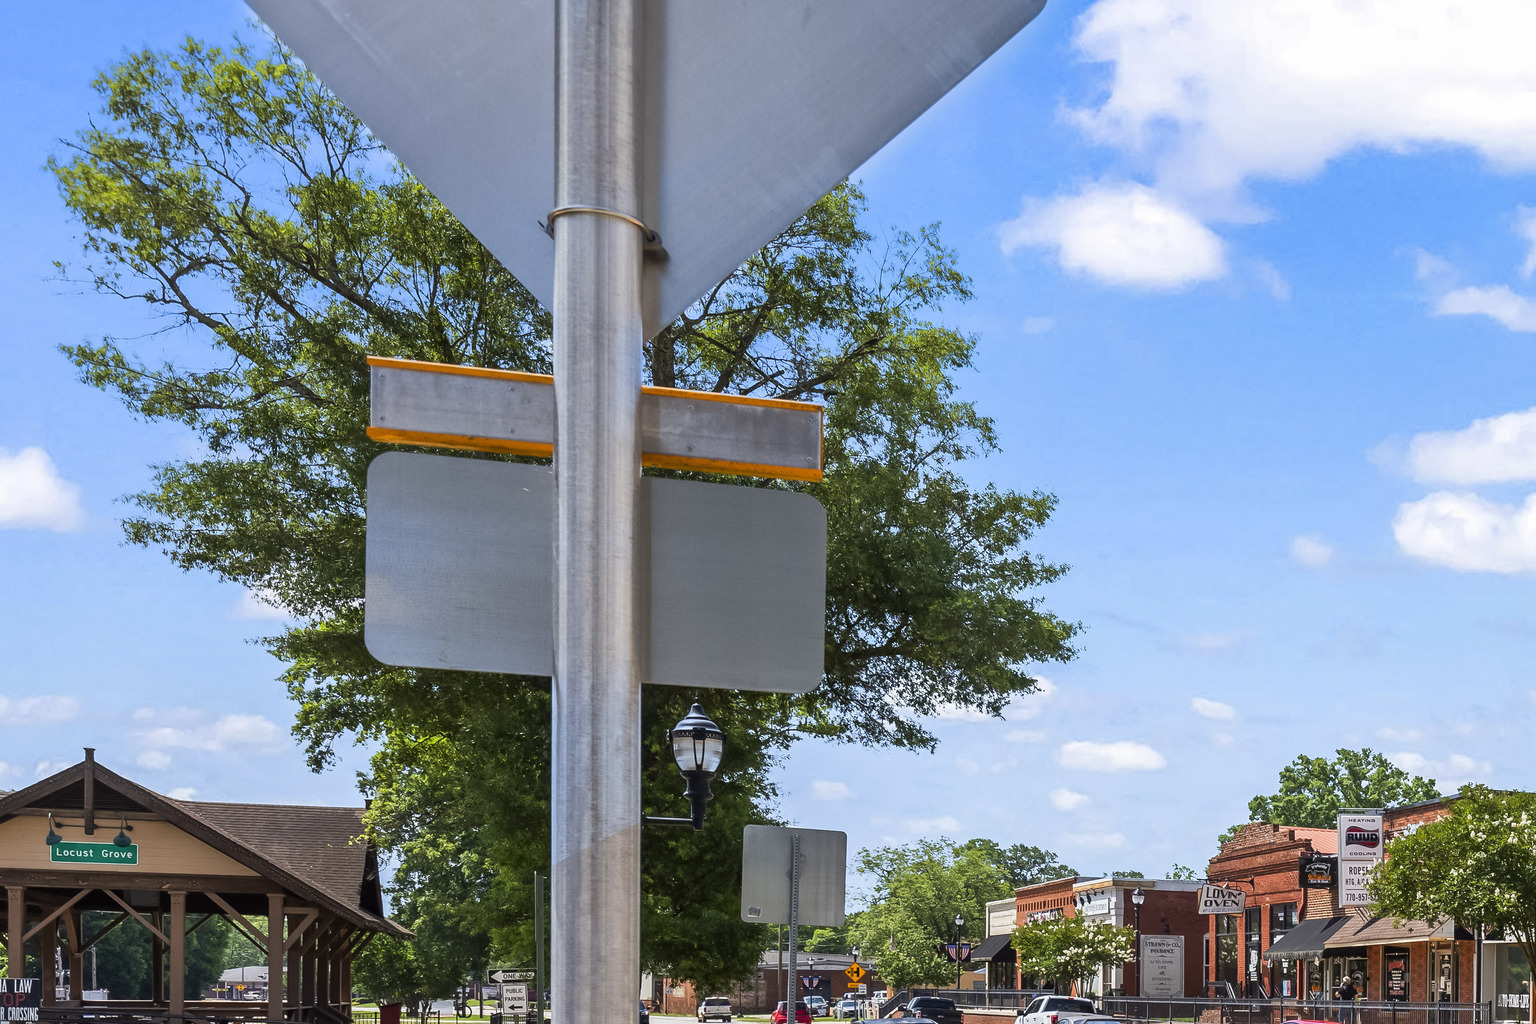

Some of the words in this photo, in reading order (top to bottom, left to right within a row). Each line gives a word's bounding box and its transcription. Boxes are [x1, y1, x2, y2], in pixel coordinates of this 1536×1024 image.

[1347, 833, 1379, 841] RUUD
[56, 848, 94, 858] Locust
[101, 849, 133, 859] Grove
[1206, 886, 1242, 899] LOVIN'
[1204, 899, 1240, 907] OVEN
[14, 979, 33, 994] LAW
[7, 1006, 39, 1021] CROSSING
